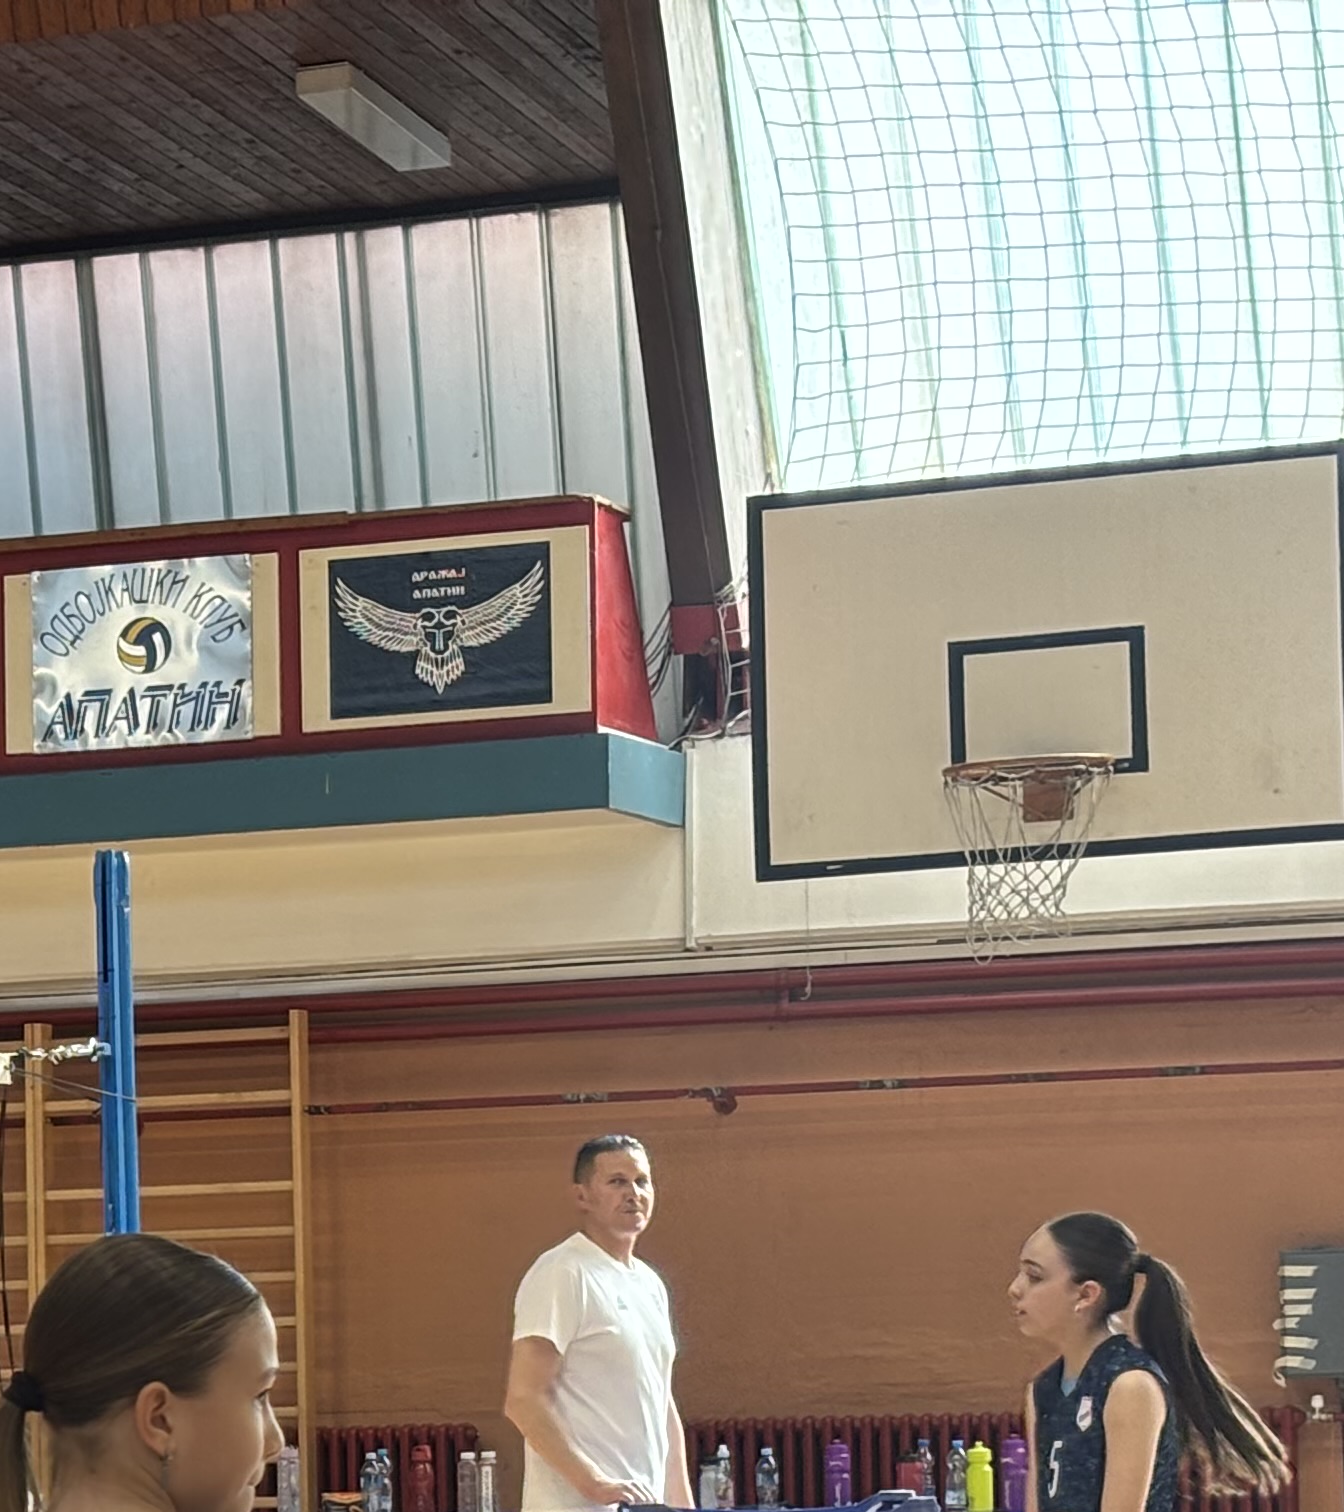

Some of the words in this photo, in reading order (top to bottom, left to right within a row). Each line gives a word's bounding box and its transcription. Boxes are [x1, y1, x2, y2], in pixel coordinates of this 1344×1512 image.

[39, 567, 190, 657] ОДБОЈКАШКИ
[182, 582, 247, 644] КЛУБ
[41, 678, 247, 743] АПАТИН
[1047, 1440, 1063, 1498] 5
